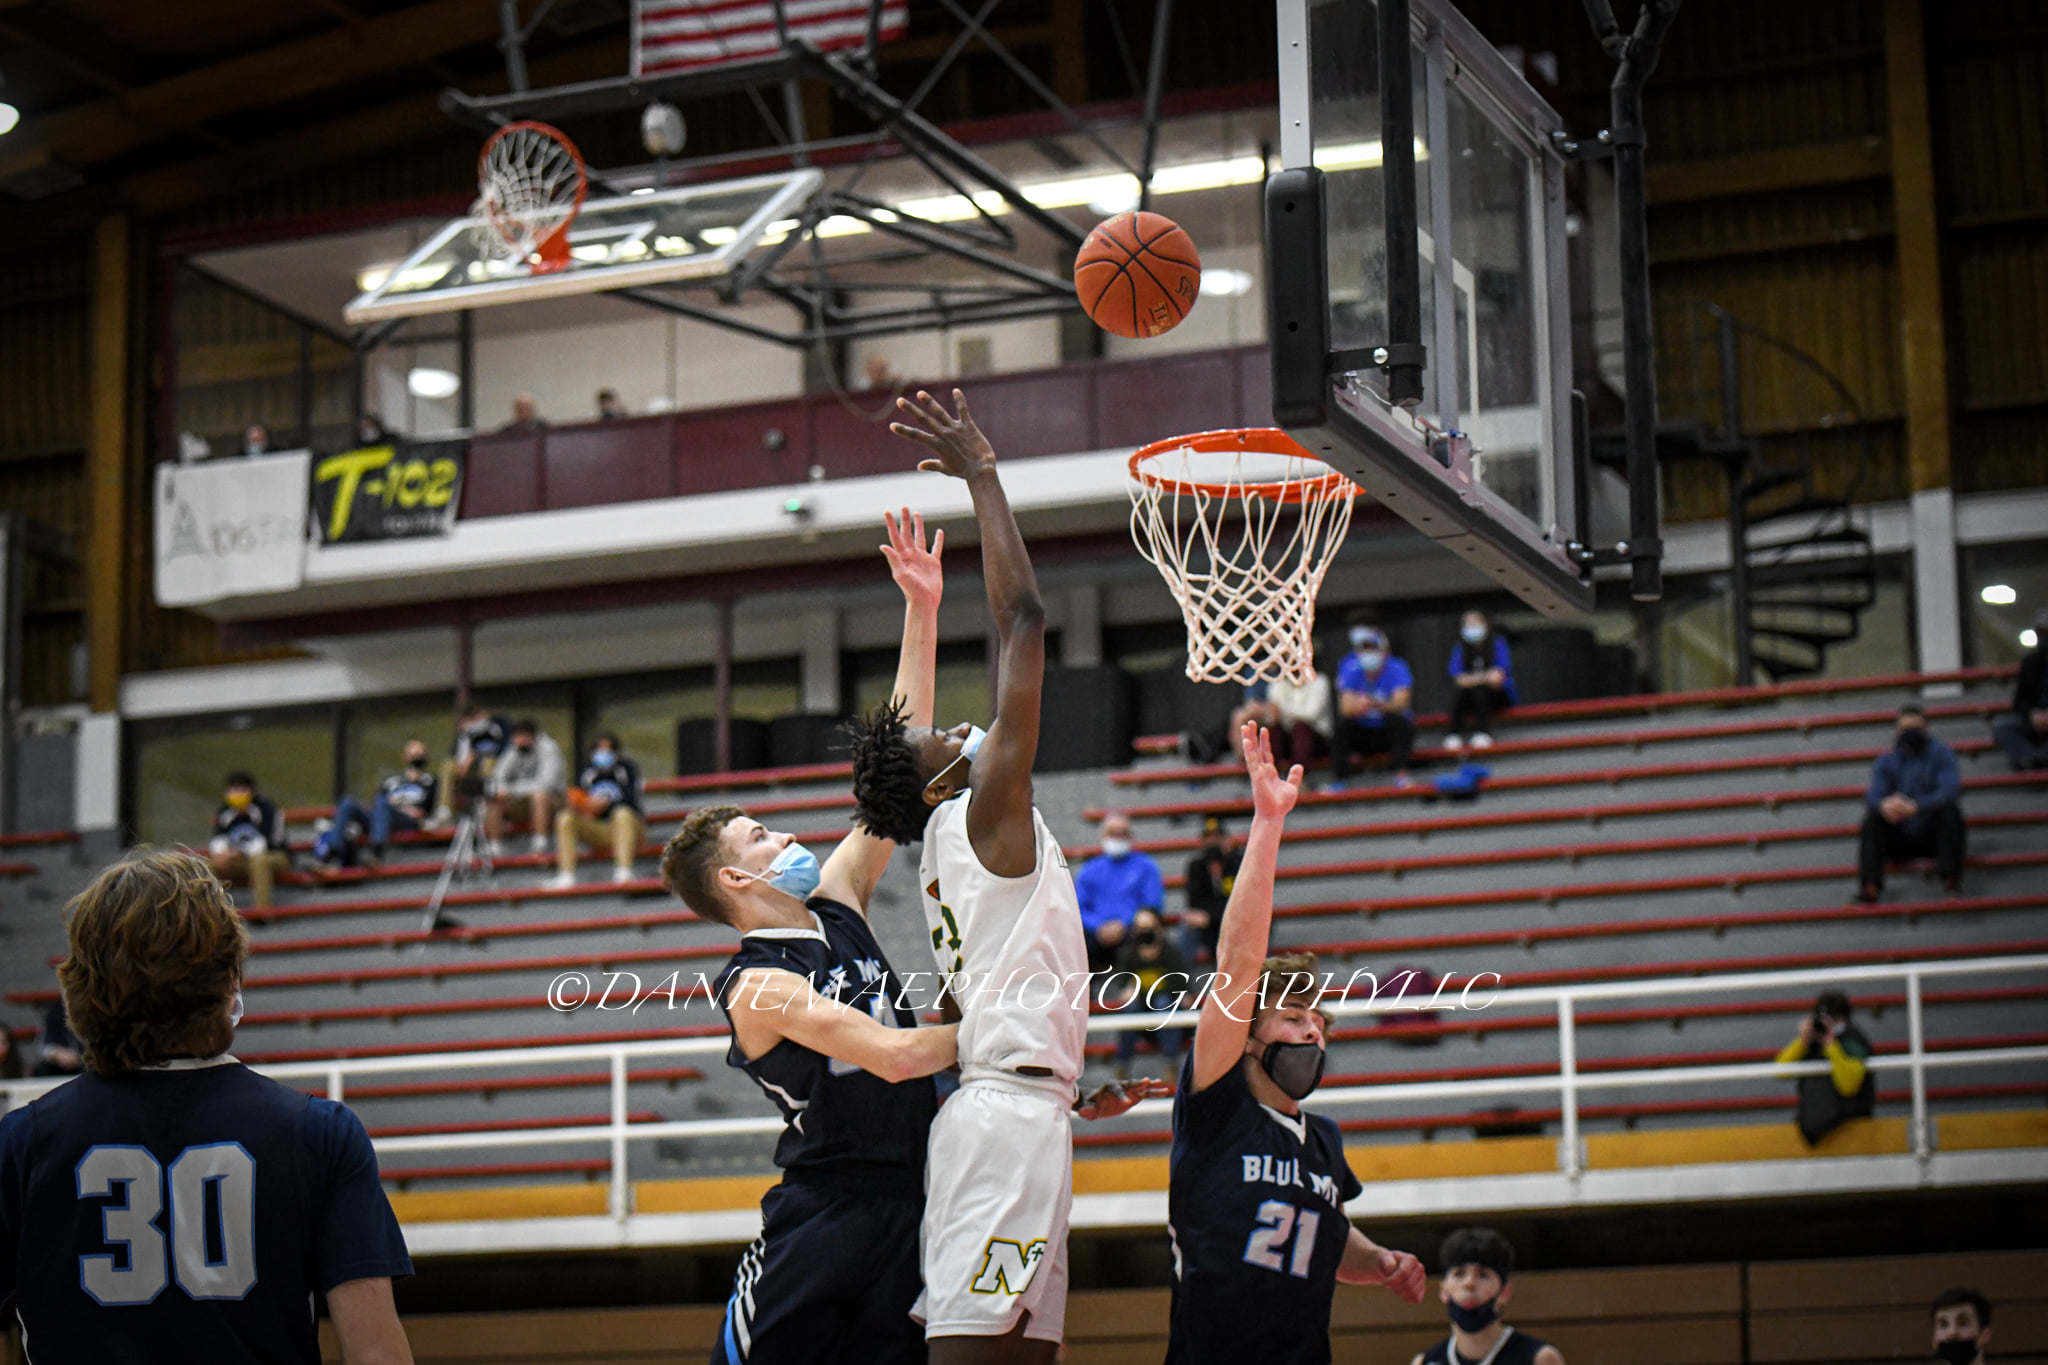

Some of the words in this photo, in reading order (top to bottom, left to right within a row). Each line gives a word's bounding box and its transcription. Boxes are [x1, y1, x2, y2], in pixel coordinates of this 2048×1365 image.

[315, 445, 457, 541] T-102
[74, 1141, 258, 1306] 30
[1242, 1199, 1320, 1279] 21
